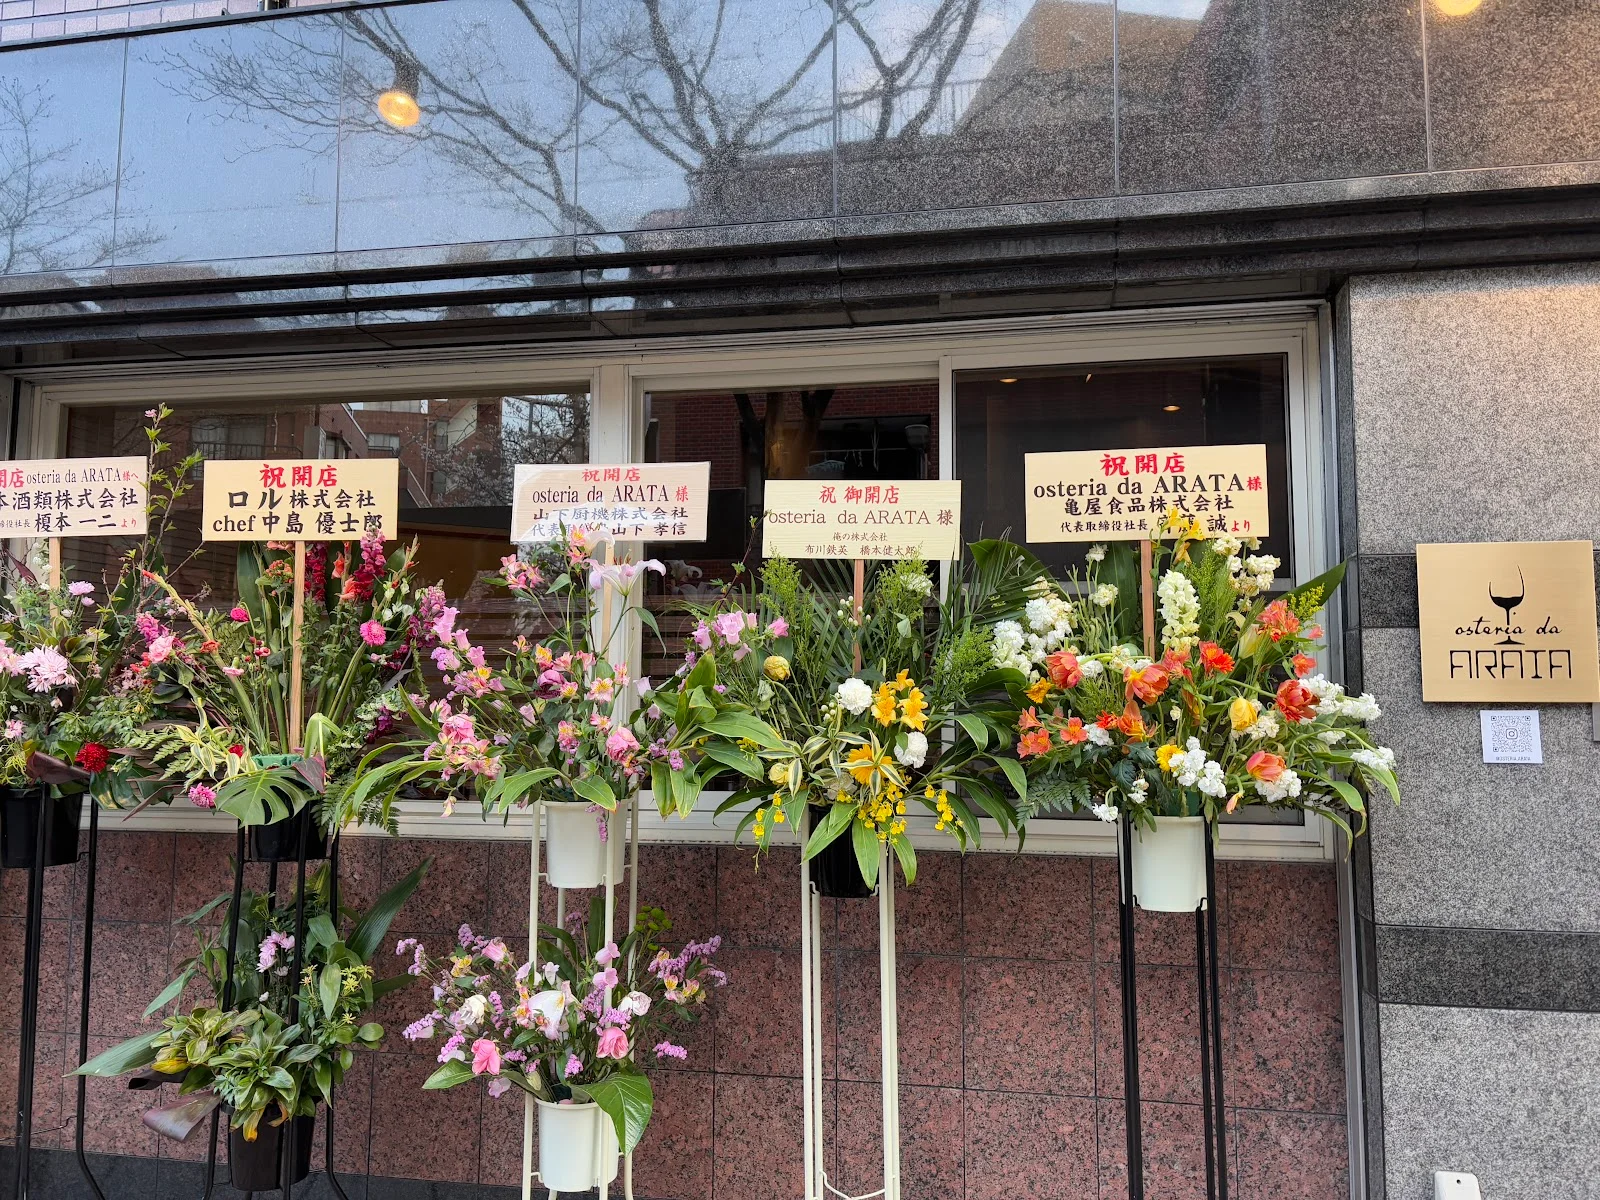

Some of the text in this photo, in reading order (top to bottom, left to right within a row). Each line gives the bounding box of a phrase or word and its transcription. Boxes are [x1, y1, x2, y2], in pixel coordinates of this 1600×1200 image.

[1099, 452, 1187, 477] 祝開店
[26, 468, 61, 484] osteria
[64, 468, 77, 483] da
[80, 467, 122, 483] ARATA
[259, 463, 338, 489] 祝開店
[582, 467, 641, 482] 祝開店
[533, 484, 689, 503] osteria da ARATA 様
[1033, 473, 1263, 498] osteria da ARATA 様
[533, 506, 689, 521] 山下厨機株式会社
[1064, 494, 1235, 516] 亀屋食品株式会社
[213, 515, 256, 532] chef
[768, 509, 954, 526] osteria da ARATA 様
[1060, 518, 1148, 533] 代表取締役社長
[1455, 614, 1563, 636] osteria da
[1450, 650, 1572, 679] ARATA
